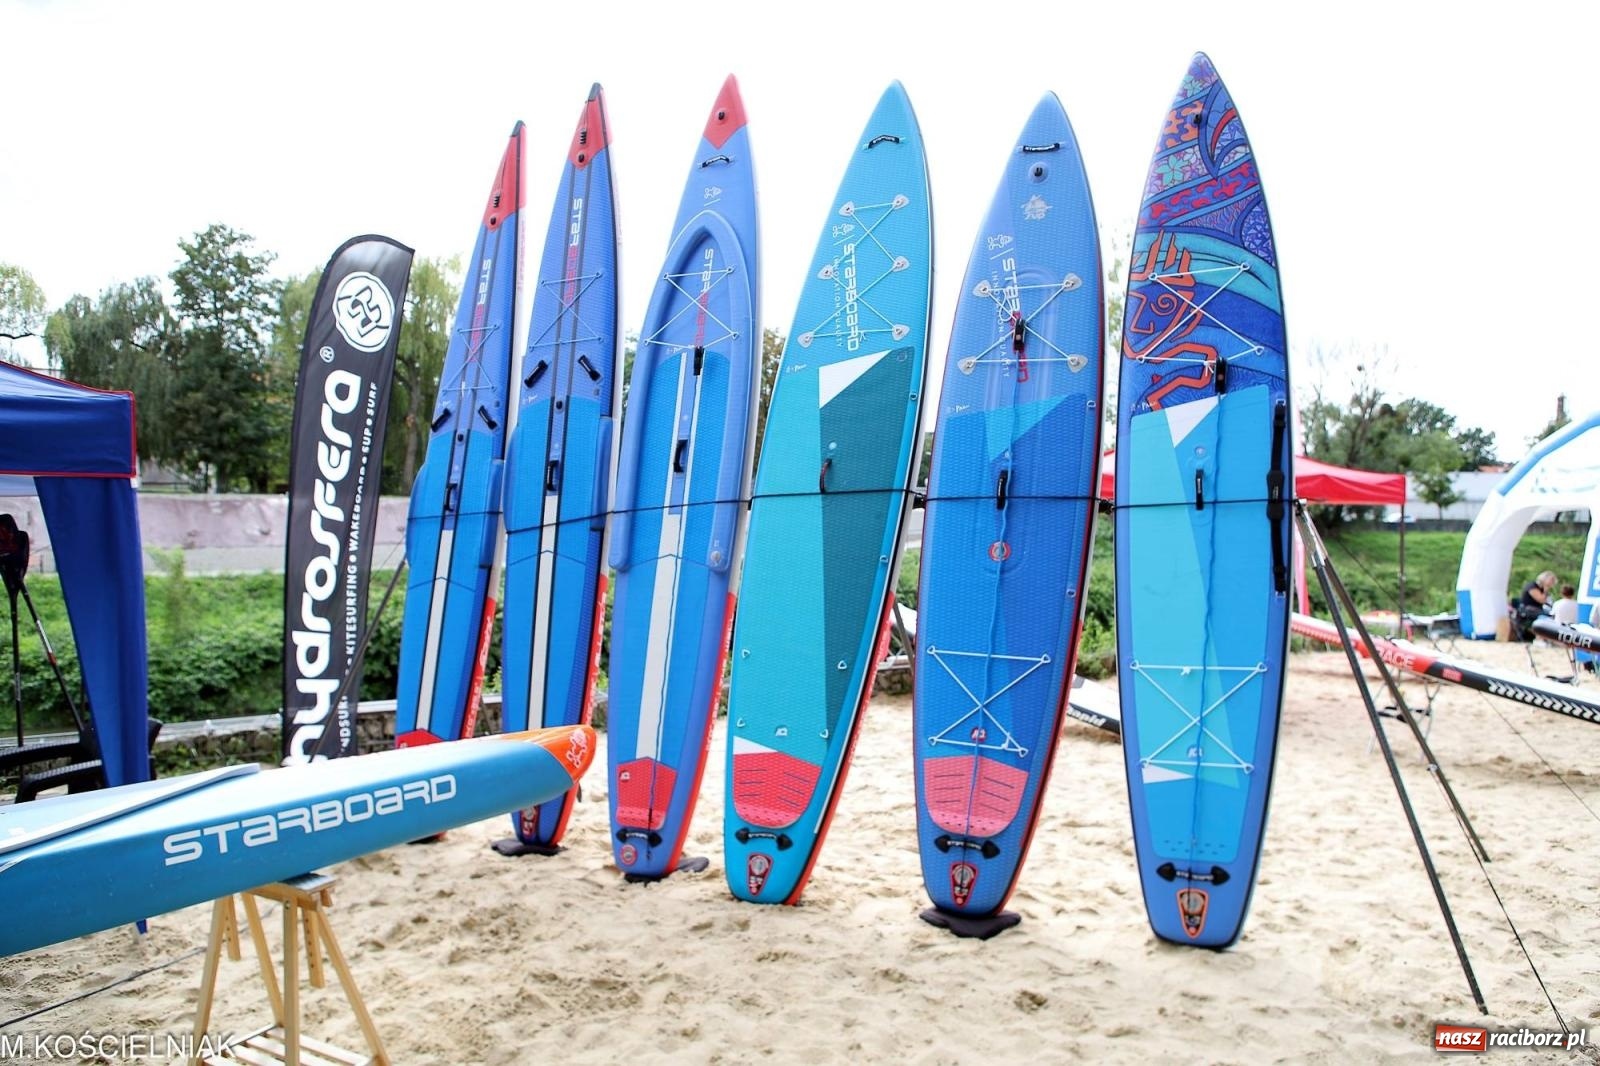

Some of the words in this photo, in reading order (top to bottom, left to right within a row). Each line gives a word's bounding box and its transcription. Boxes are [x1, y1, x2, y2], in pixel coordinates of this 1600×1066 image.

[366, 382, 378, 416] SURF
[361, 428, 373, 453] SUP
[281, 369, 362, 766] hydrosfera
[345, 565, 358, 655] KITESURFING
[1557, 629, 1593, 649] TOUR
